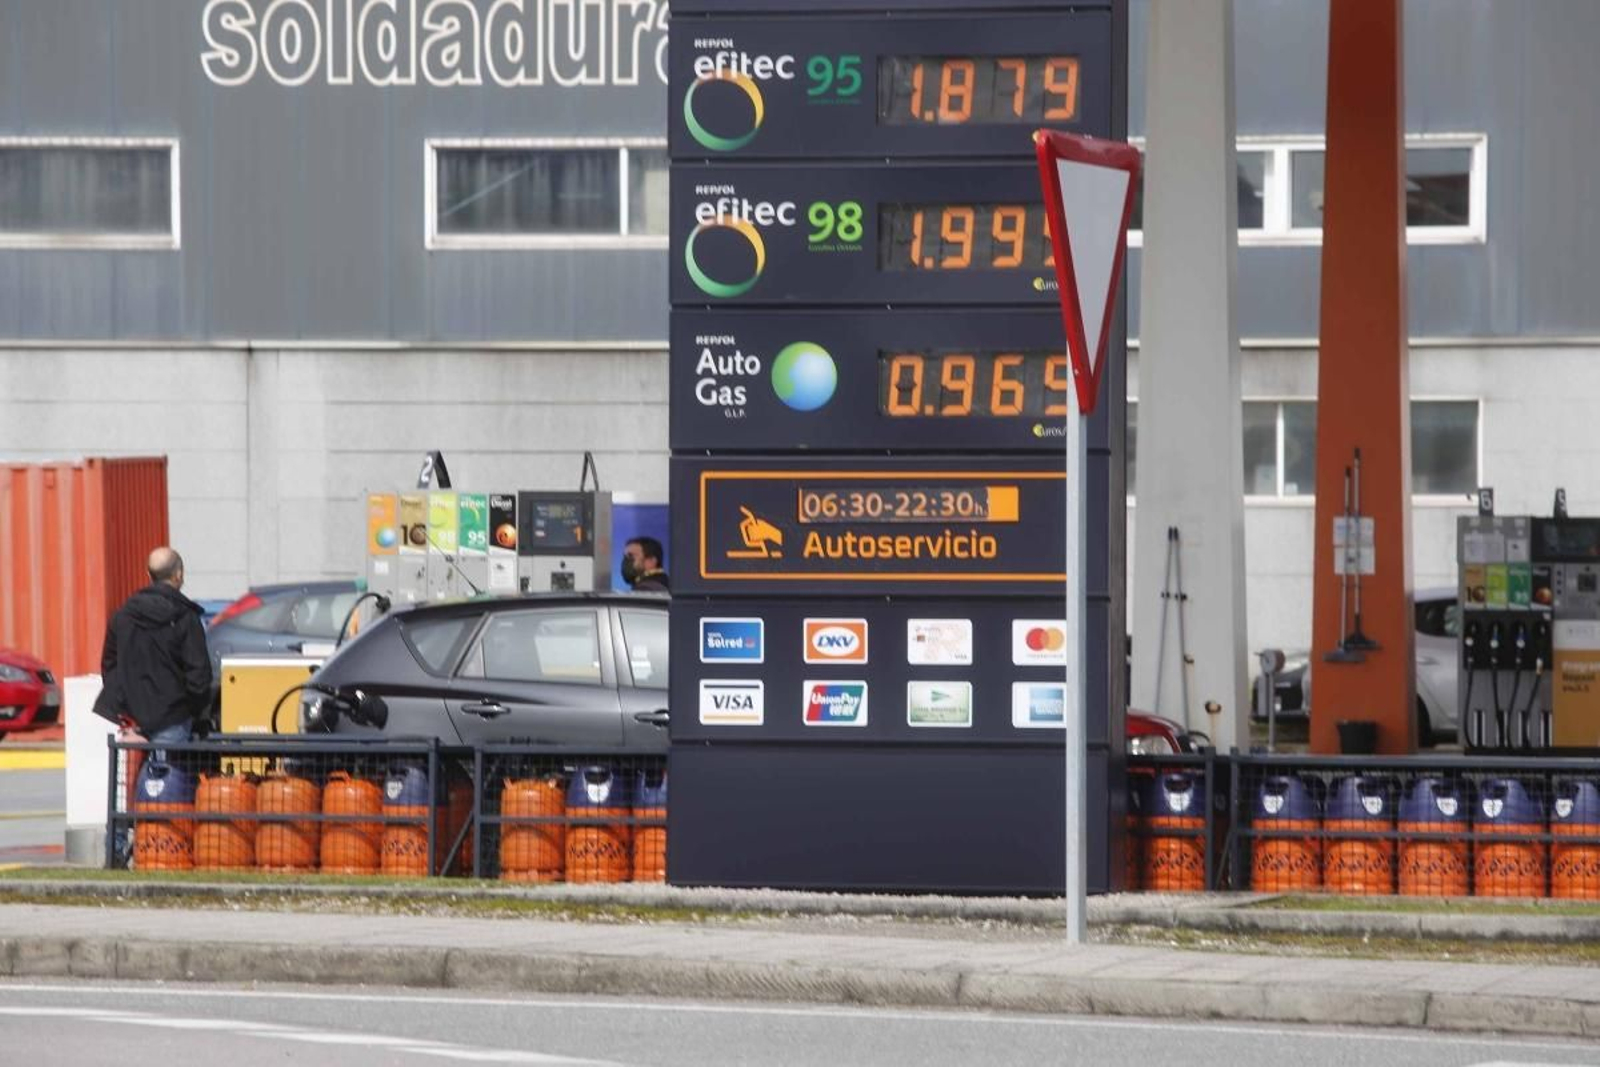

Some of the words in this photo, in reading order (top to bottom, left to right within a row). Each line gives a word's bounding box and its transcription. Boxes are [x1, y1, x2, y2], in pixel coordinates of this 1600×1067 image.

[200, 0, 668, 86] soldadur
[694, 51, 795, 80] efitec
[806, 55, 862, 96] 95
[911, 58, 1079, 123] 1.879
[695, 197, 796, 226] efitec
[808, 201, 863, 242] 98
[695, 348, 761, 376] Auto
[695, 378, 747, 405] Gas
[420, 456, 433, 483] 2
[1480, 491, 1492, 511] 6
[468, 530, 486, 544] 95
[803, 530, 997, 559] Autoservicio
[817, 634, 854, 648] DKV
[712, 694, 754, 710] VISA
